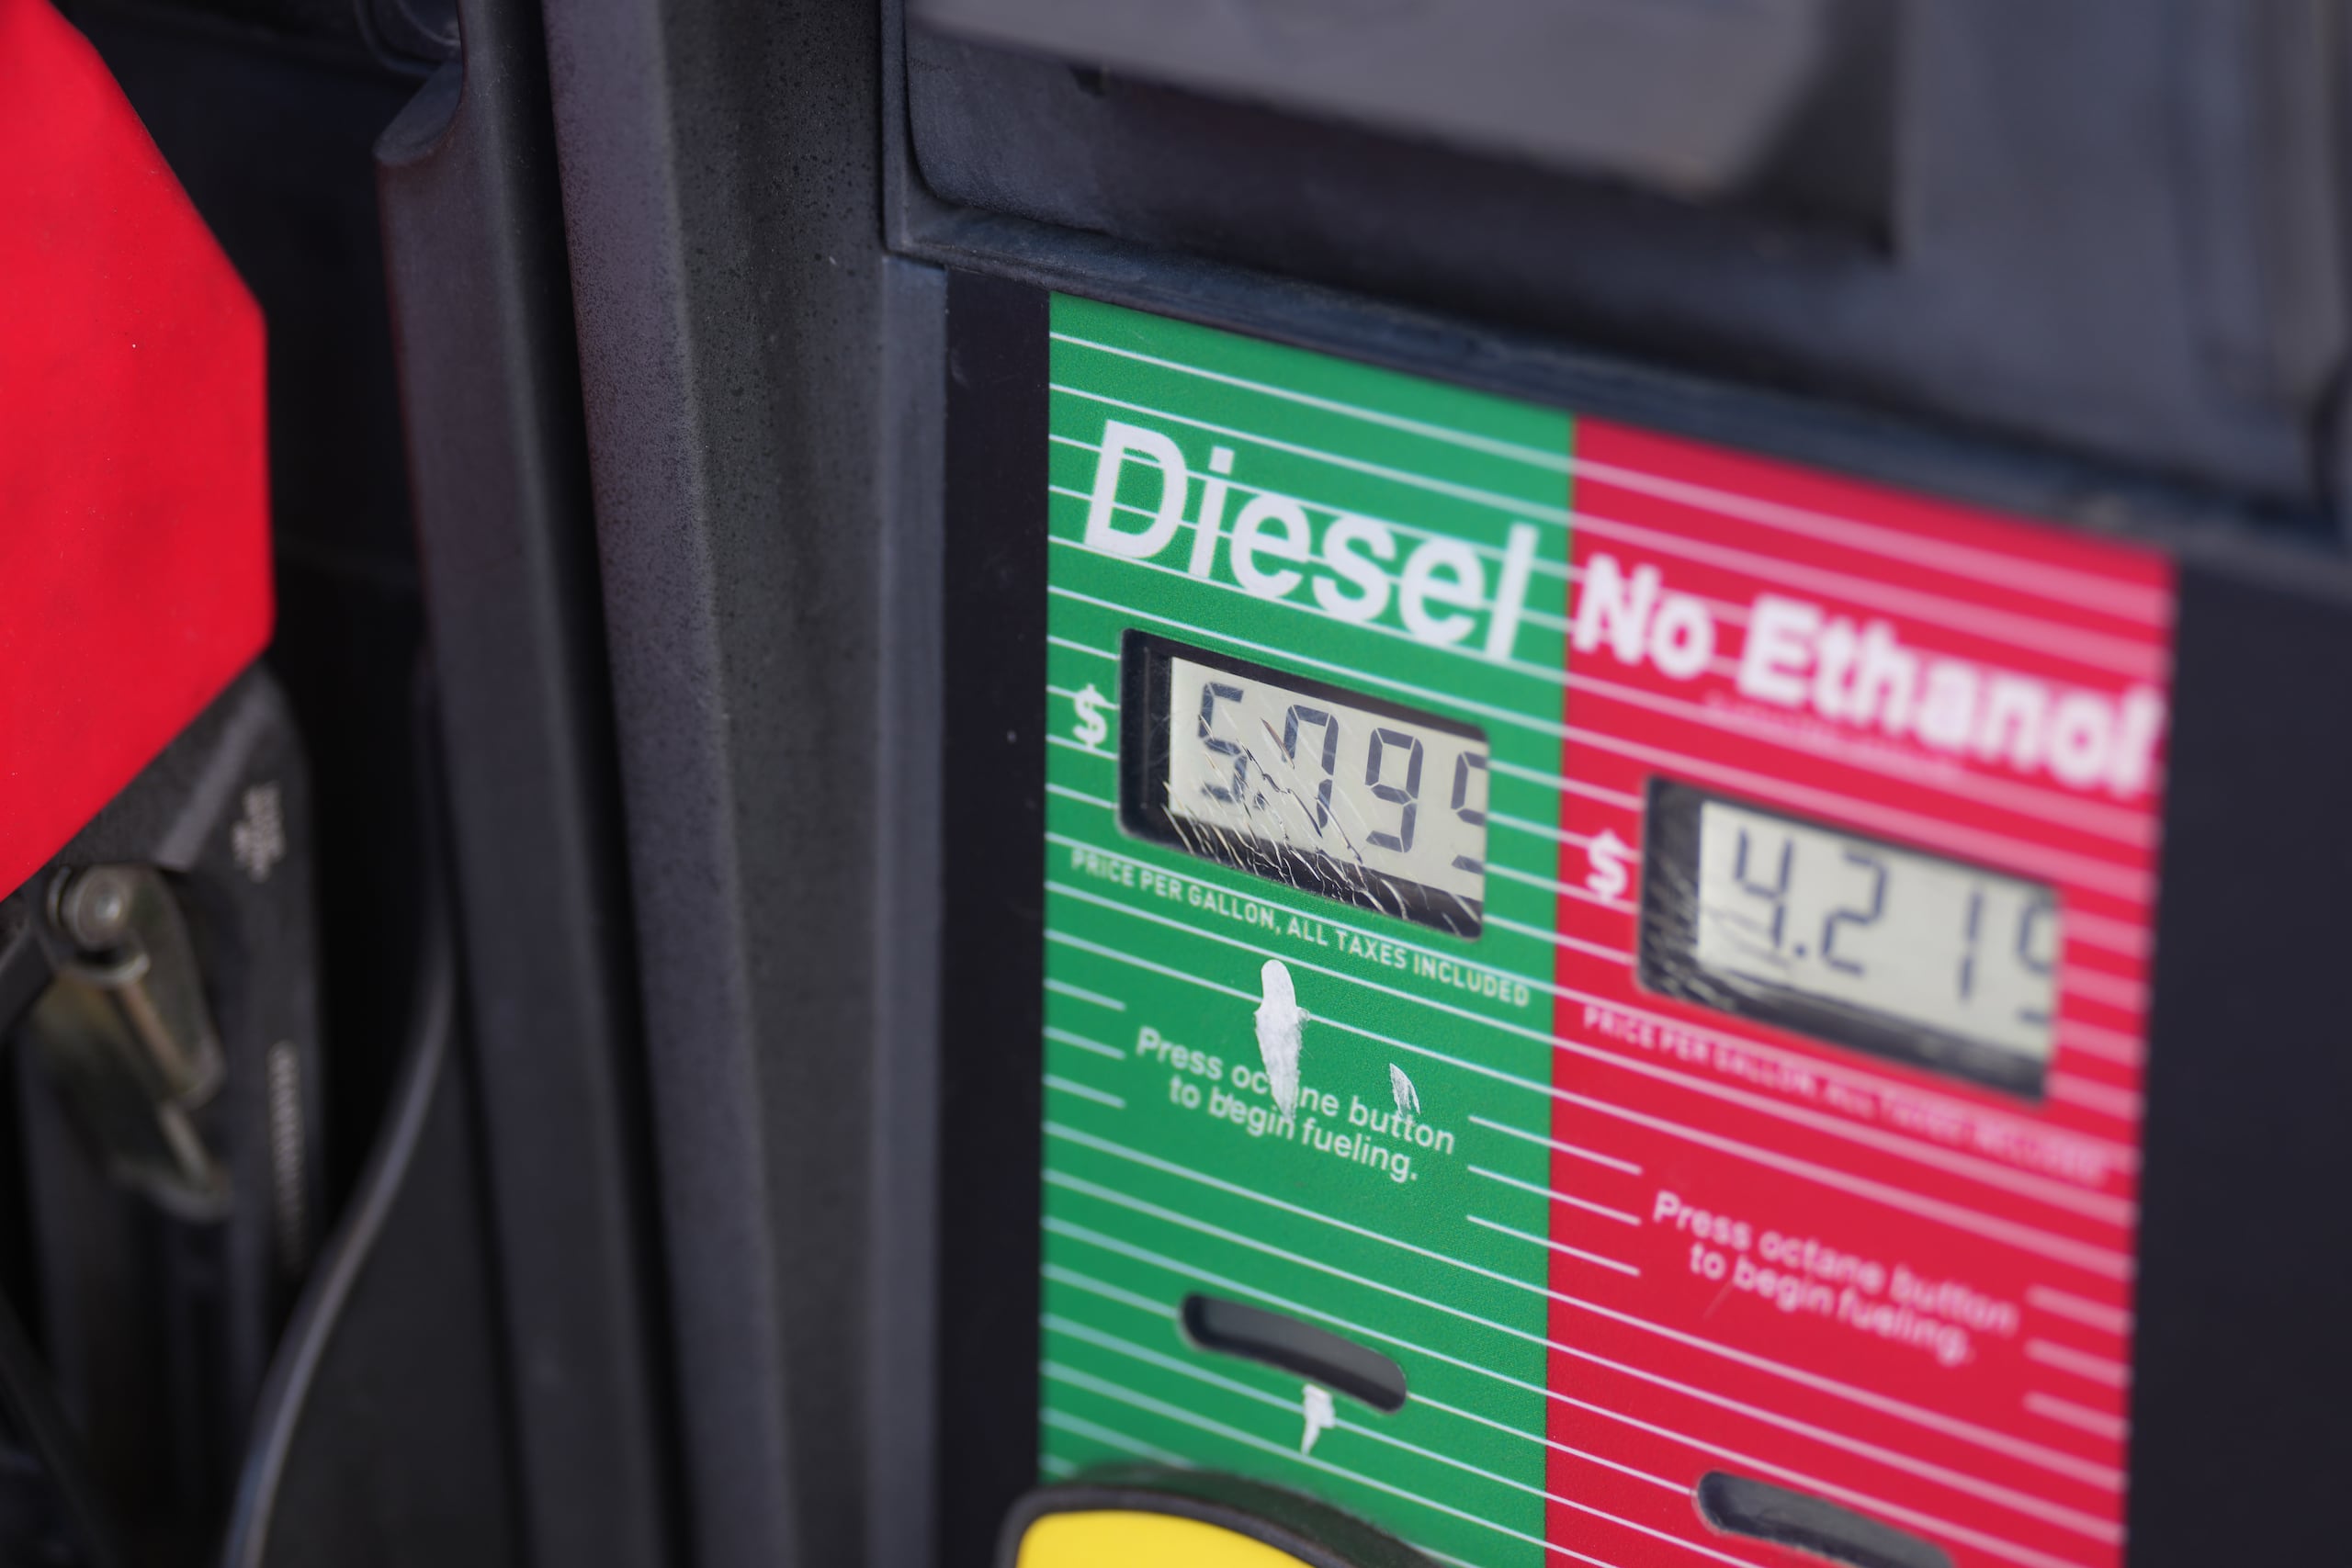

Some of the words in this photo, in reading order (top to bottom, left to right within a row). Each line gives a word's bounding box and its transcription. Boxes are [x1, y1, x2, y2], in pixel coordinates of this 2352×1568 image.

[1084, 419, 1539, 660] Diesel
[1072, 683, 1107, 751] $
[1569, 552, 1716, 680] No
[1735, 592, 2166, 797] Ethanol
[1586, 829, 1628, 904] $
[1071, 847, 1136, 887] PRICE
[1139, 869, 1182, 902] PER
[1188, 885, 1281, 935] GALLON,
[1287, 917, 1329, 946] ALL
[1337, 930, 1407, 969] TAXES
[1413, 953, 1531, 1008] INCLUDED
[1136, 1025, 1223, 1081] Press
[1231, 1064, 1340, 1118] ocne
[1348, 1096, 1455, 1156] button
[1170, 1075, 1201, 1110] to
[1208, 1087, 1295, 1140] begin
[1302, 1117, 1418, 1184] fueling.
[1654, 1190, 1752, 1251] Press
[1758, 1230, 1886, 1296] octane
[1690, 1240, 1726, 1280] to
[1733, 1253, 1836, 1316] begin
